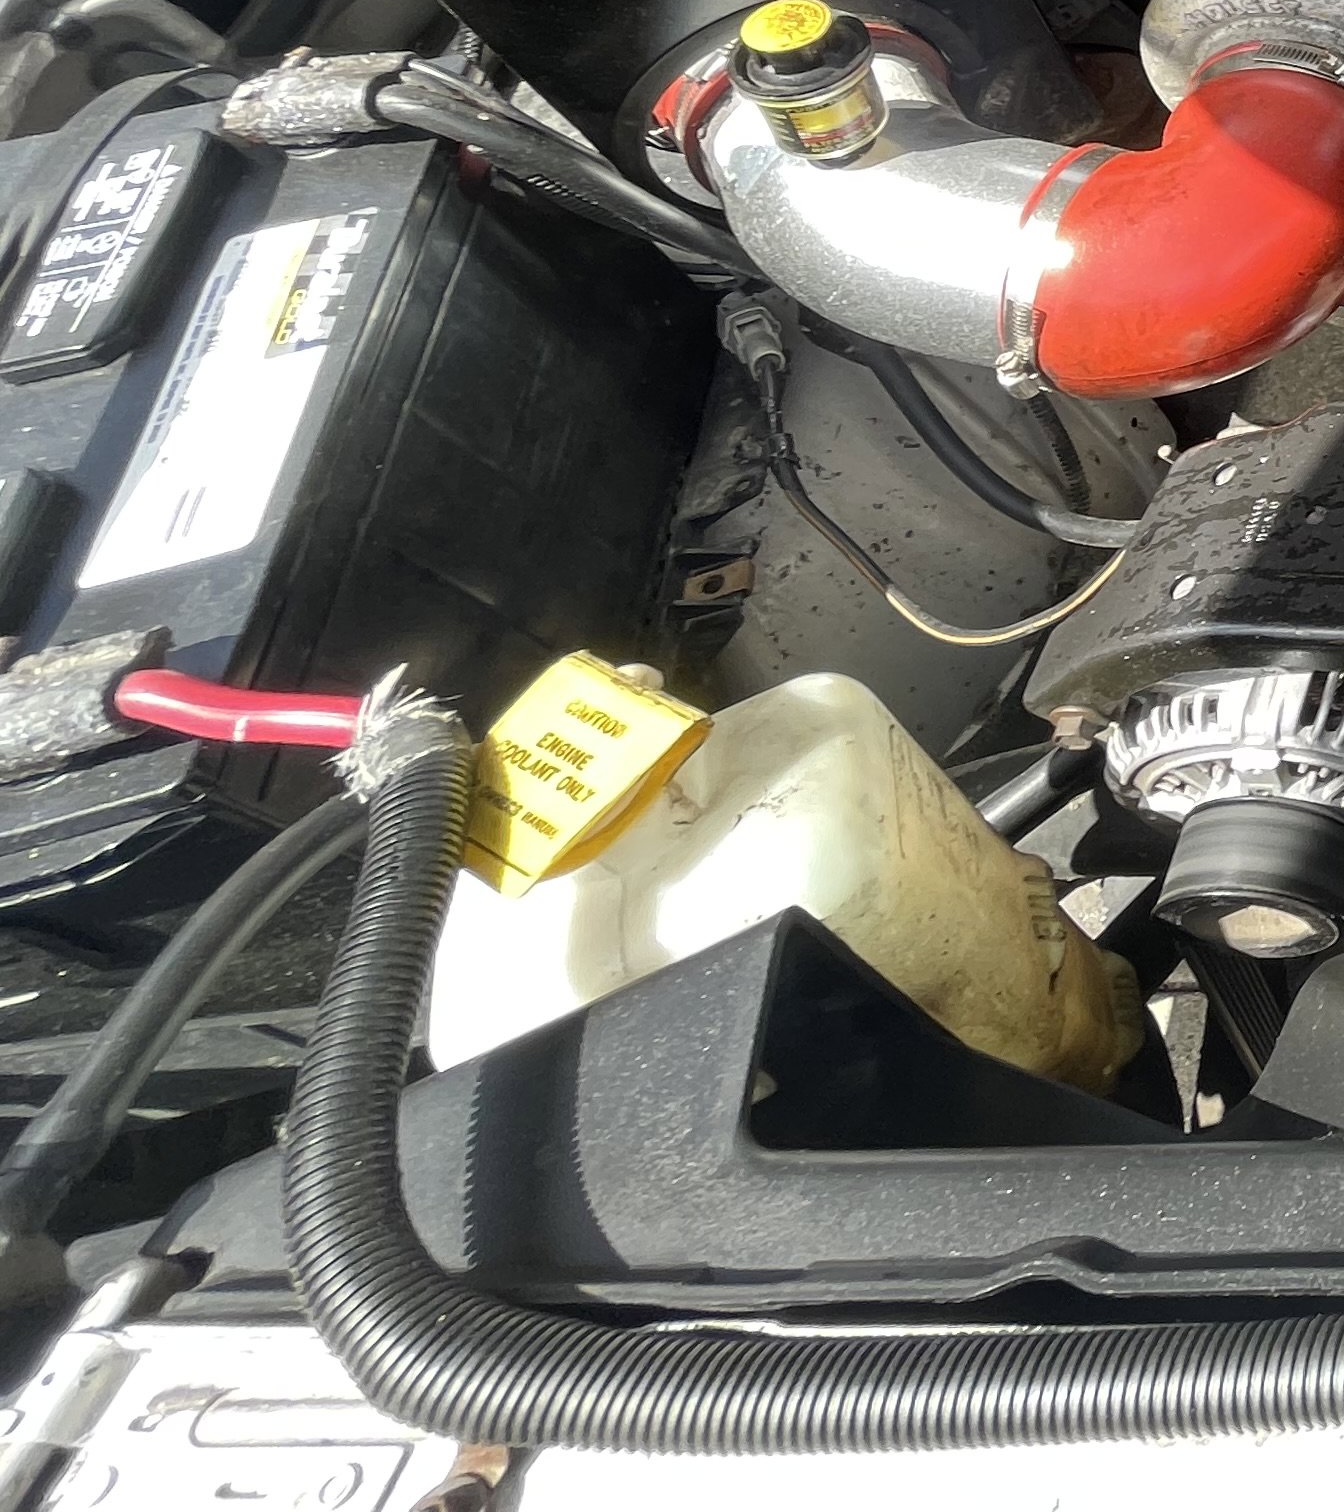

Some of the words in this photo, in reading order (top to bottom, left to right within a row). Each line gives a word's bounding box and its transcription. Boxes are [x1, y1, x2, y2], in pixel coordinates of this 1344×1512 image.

[494, 739, 562, 783] COOLANT
[555, 775, 597, 804] ONLY
[535, 731, 595, 772] ENGINE
